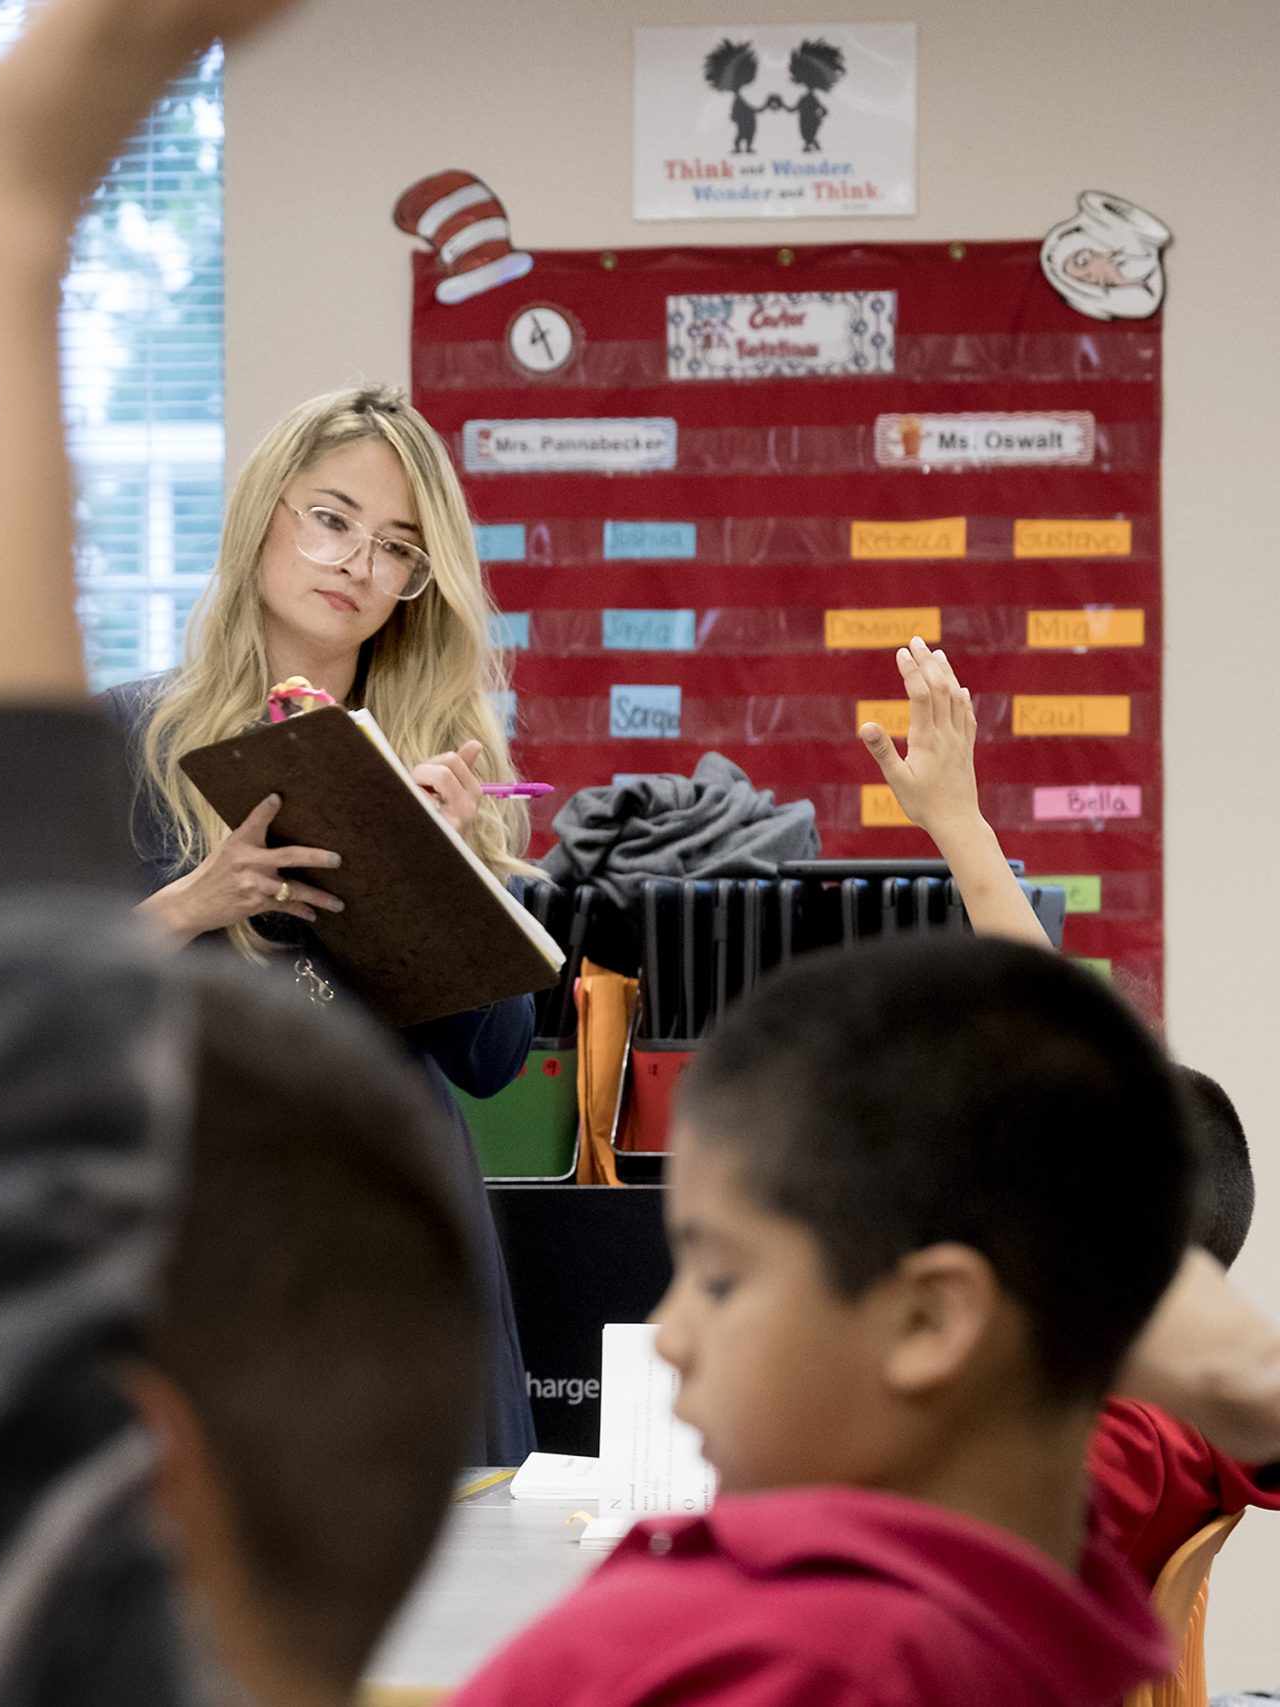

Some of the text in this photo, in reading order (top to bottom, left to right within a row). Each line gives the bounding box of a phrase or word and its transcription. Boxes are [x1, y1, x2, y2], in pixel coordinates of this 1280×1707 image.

[663, 158, 734, 180] Think
[740, 164, 766, 176] and
[779, 186, 805, 199] and
[540, 434, 665, 451] Pannabecker
[985, 430, 1064, 450] Oswalt
[1019, 524, 1121, 551] Gustavo
[1034, 616, 1090, 642] Mia
[1067, 787, 1130, 814] Bella
[525, 1371, 600, 1405] harge
[610, 1498, 622, 1510] N
[683, 1497, 696, 1510] O
